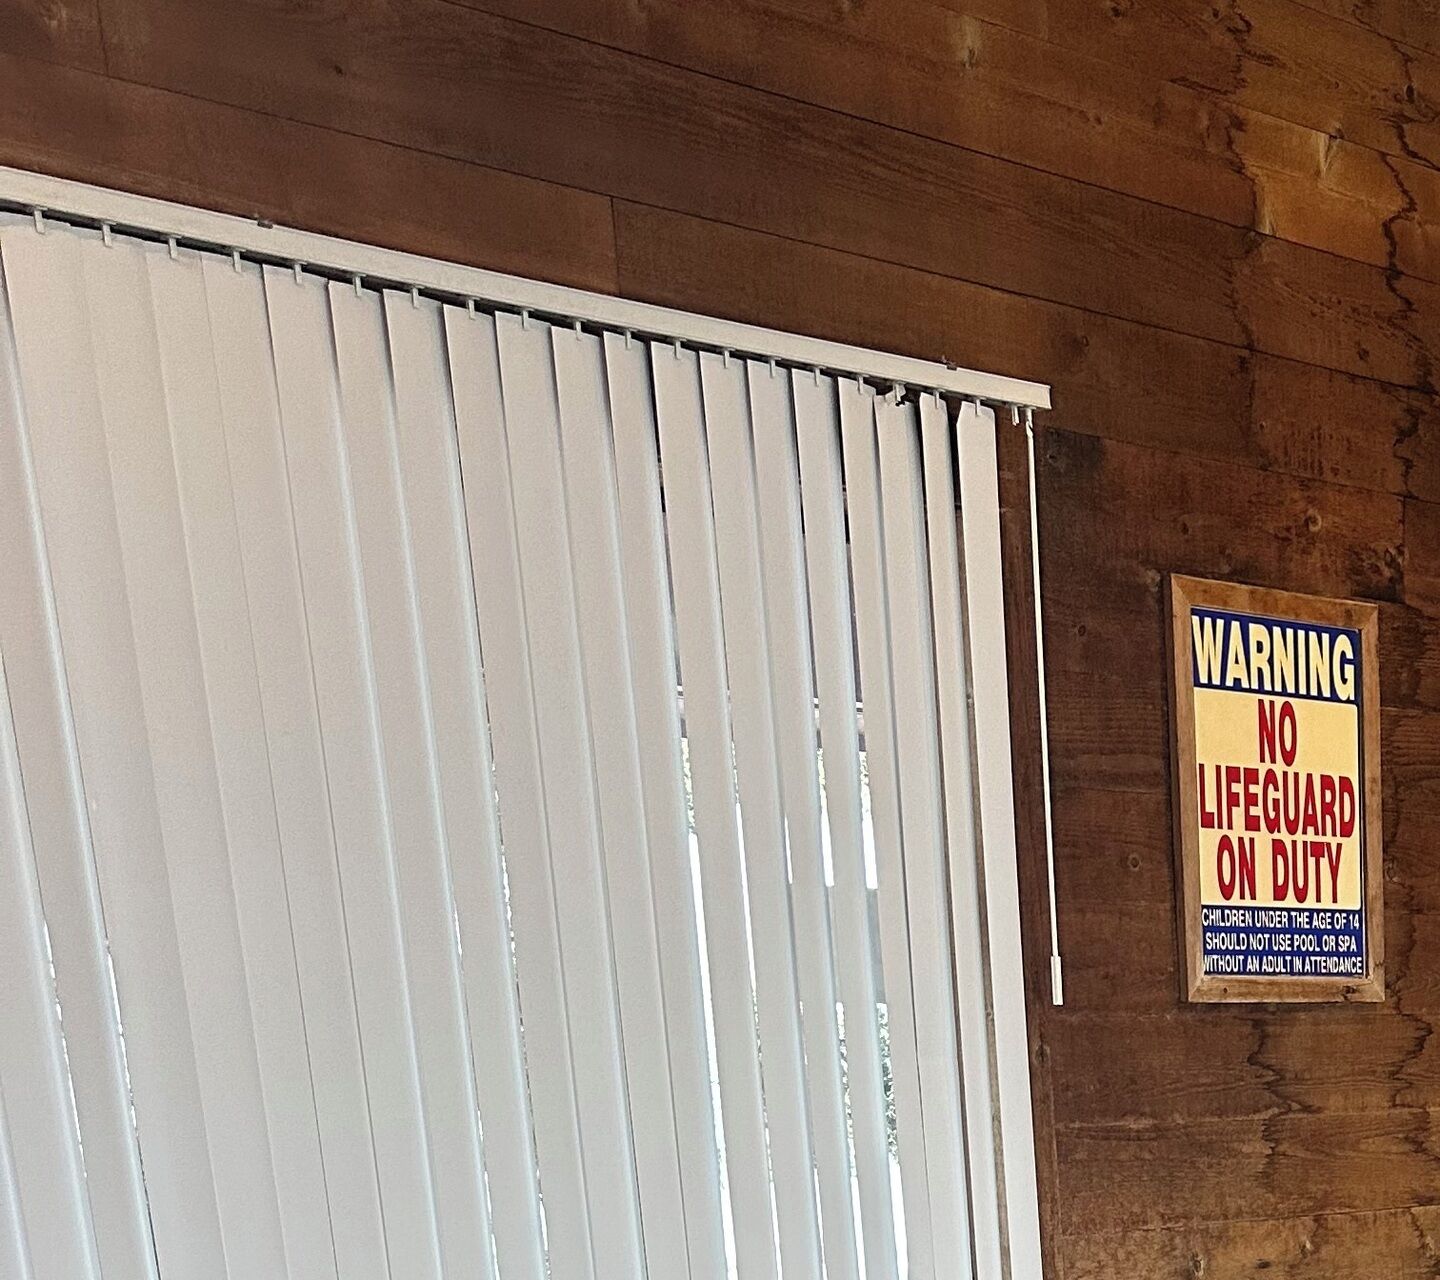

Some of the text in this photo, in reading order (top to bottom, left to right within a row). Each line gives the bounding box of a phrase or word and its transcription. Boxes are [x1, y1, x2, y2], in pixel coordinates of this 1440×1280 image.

[1191, 615, 1355, 701] WARNING
[1258, 699, 1297, 767] NO
[1198, 763, 1355, 838] LIFEGUARD
[1217, 834, 1342, 904] ON DUTY
[1201, 908, 1360, 930] CHILDREN UNDER THE AGE OF 14
[1205, 931, 1357, 953] SHOULD NOT USE POOL OR SPA
[1203, 954, 1363, 974] WITHOUT AN ADULT IN ATTENDANCE
